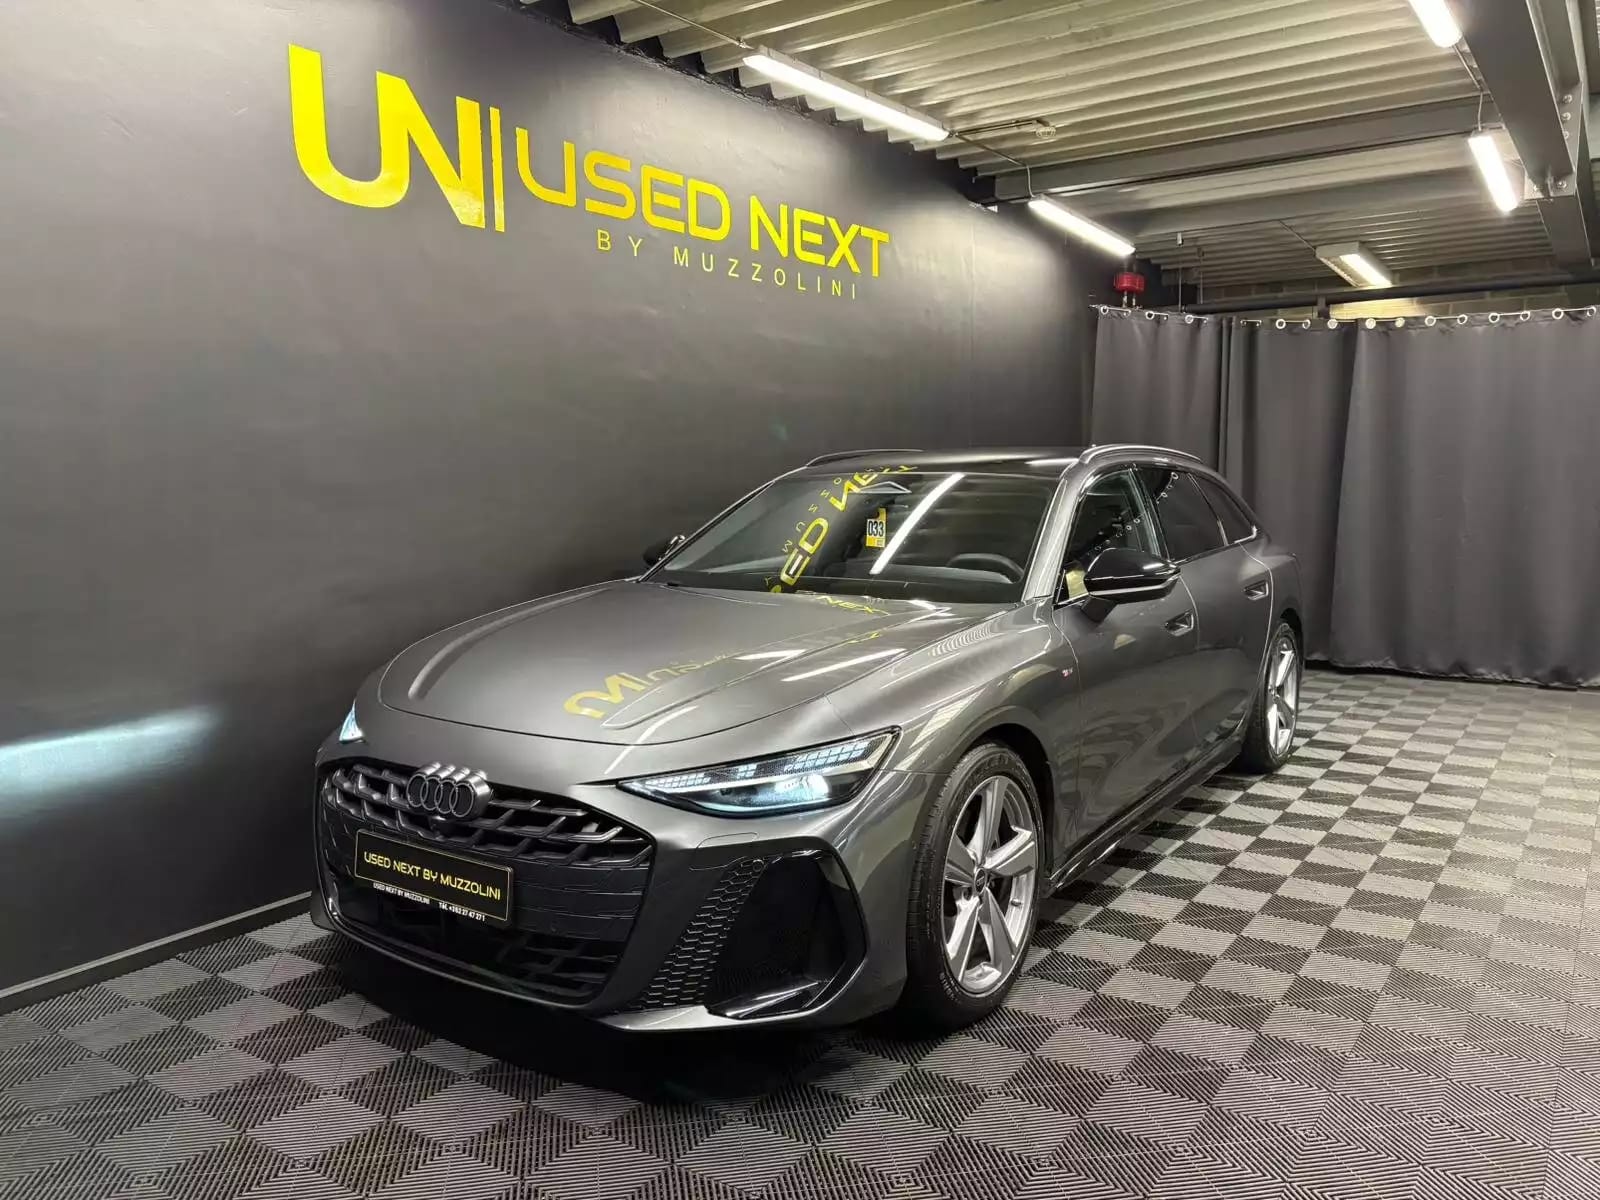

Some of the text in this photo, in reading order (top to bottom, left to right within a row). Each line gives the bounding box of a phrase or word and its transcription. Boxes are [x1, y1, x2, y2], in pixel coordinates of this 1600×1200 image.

[515, 127, 890, 277] USED NEXT
[597, 229, 857, 300] BY MUZZOLINI
[868, 520, 884, 537] 033
[364, 851, 501, 901] USED NEXT BY MUZZOLINI
[373, 882, 386, 891] USED
[386, 886, 397, 895] NEXT
[404, 891, 430, 905] MUZZOLINI
